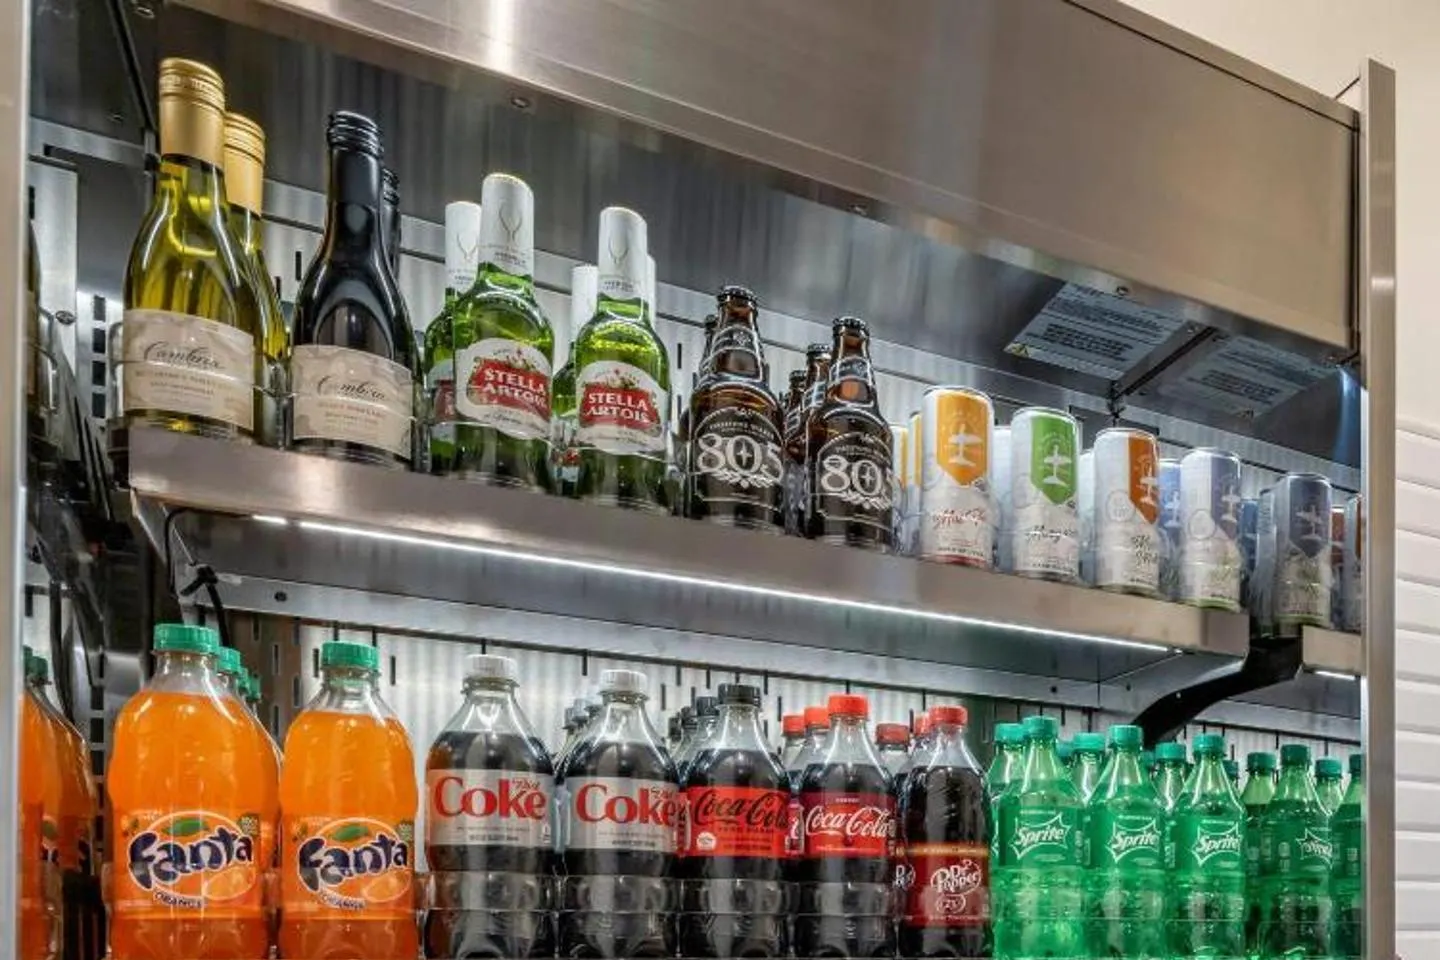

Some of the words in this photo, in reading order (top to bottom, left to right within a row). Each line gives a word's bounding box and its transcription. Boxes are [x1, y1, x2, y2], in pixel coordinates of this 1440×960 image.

[483, 369, 546, 395] STELLA
[586, 405, 650, 424] ARTOIS
[589, 392, 648, 412] STELLA
[698, 433, 784, 484] 805
[433, 775, 546, 821] Coke
[576, 783, 677, 828] Coke
[1015, 823, 1065, 846] Sprite
[1111, 830, 1159, 851] Sprite
[1199, 833, 1241, 853] Sprite
[129, 827, 253, 890] Fanta
[298, 834, 408, 892] Fanta
[937, 866, 979, 893] Pepper
